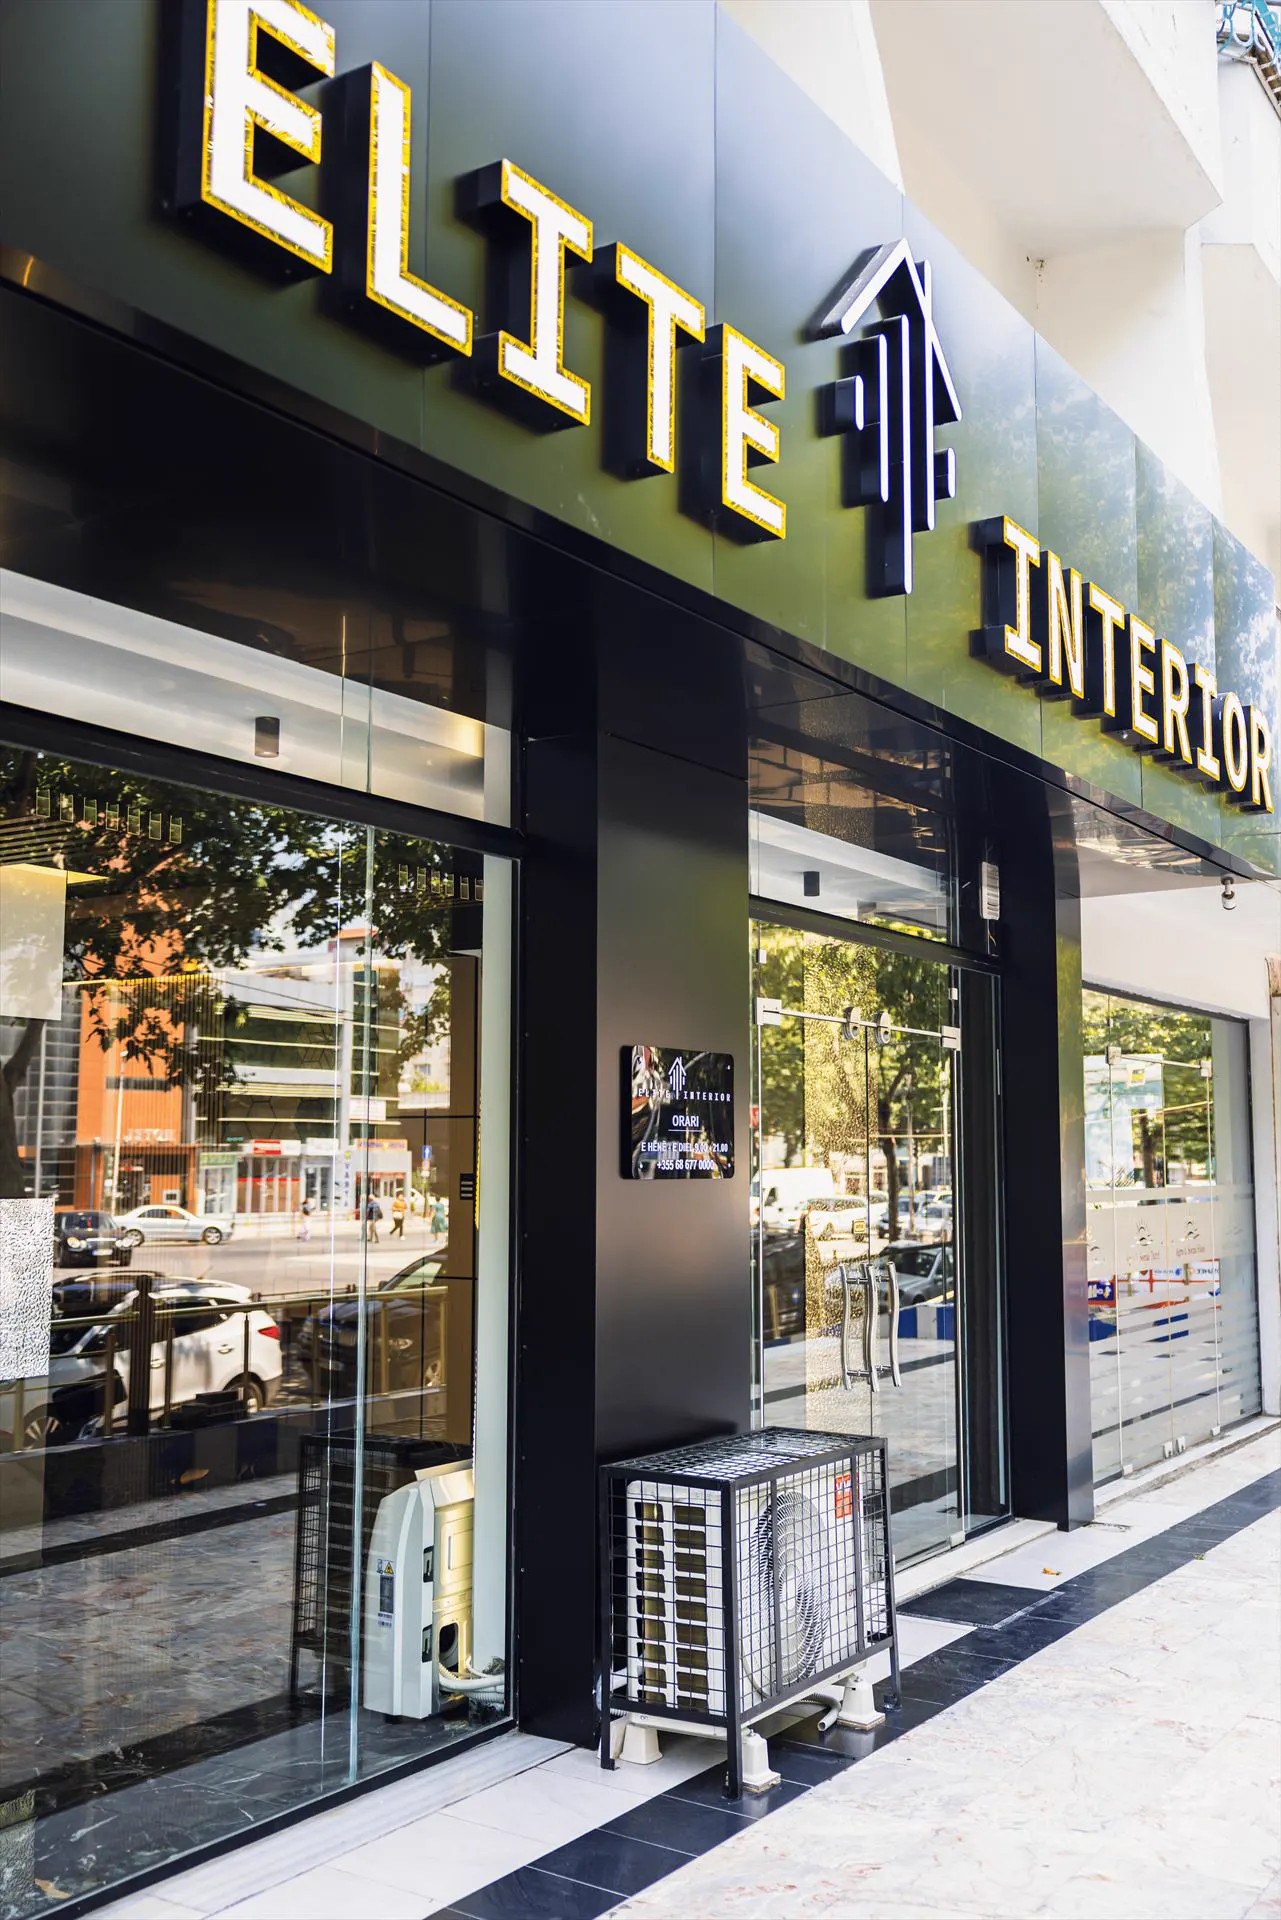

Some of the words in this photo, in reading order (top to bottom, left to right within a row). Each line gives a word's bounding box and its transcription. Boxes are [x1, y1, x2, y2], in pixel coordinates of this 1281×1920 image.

[202, 0, 786, 540] ELITE
[1004, 515, 1274, 814] INTERIOR
[684, 1091, 731, 1102] INTERIOR
[672, 1115, 699, 1127] ORARI
[641, 1142, 647, 1152] E
[657, 1160, 674, 1170] +355
[675, 1160, 684, 1170] 68
[685, 1160, 697, 1170] 677
[698, 1160, 714, 1170] 0000
